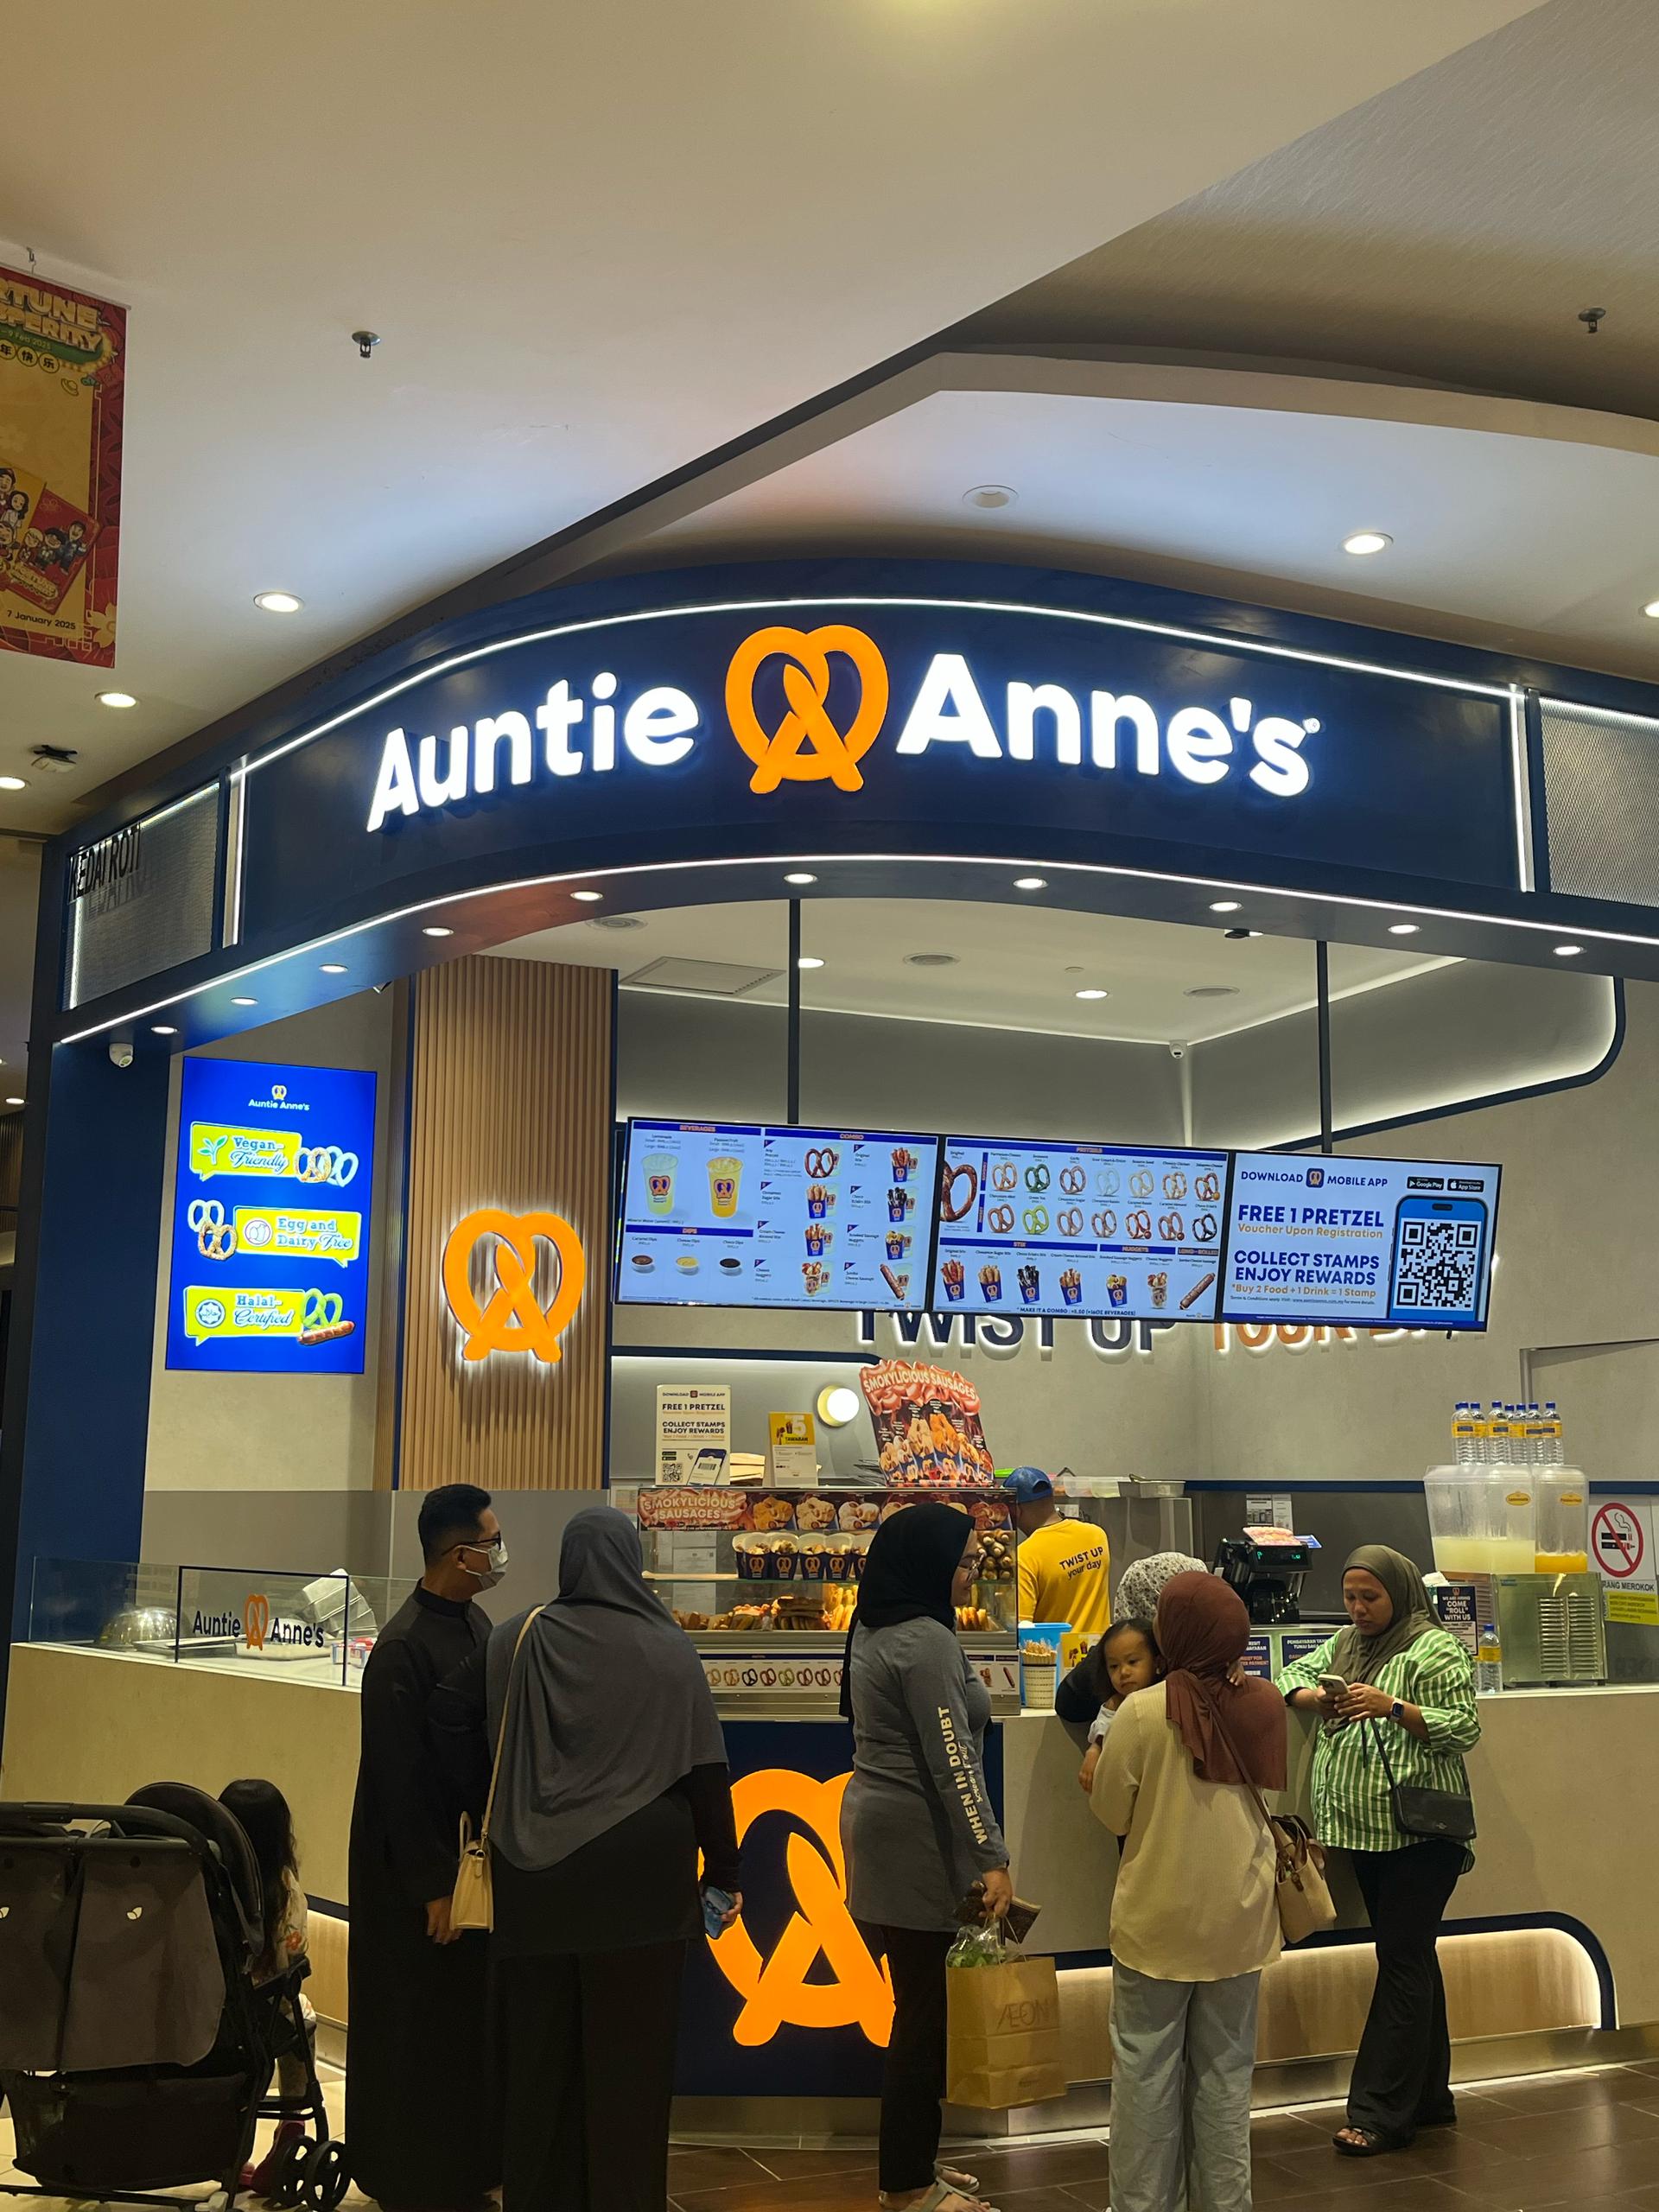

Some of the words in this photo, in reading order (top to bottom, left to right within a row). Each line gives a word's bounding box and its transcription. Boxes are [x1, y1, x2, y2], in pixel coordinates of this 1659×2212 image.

[7, 609, 12, 618] 7
[15, 612, 53, 626] January
[54, 620, 76, 630] 2025
[366, 671, 699, 833] Auntie
[108, 821, 143, 882] ROTI
[248, 1098, 279, 1109] Auntie
[280, 1101, 310, 1111] Anne's
[230, 1151, 289, 1175] Friendly
[1241, 1171, 1303, 1183] DOWNLOAD
[1327, 1175, 1366, 1186] MOBILE
[1368, 1178, 1388, 1187] APP
[277, 1217, 308, 1233] Egg
[310, 1219, 336, 1231] and
[1238, 1205, 1285, 1223] FREE
[1290, 1207, 1297, 1224] 1
[1302, 1208, 1384, 1228] PRETZEL
[1238, 1224, 1285, 1235] Voucher
[1286, 1226, 1314, 1237] Upon
[1317, 1227, 1382, 1239] Registration
[276, 1234, 318, 1251] Dairy
[318, 1235, 353, 1250] Free
[1234, 1249, 1310, 1267] COLLECT
[1313, 1253, 1380, 1269] STAMPS
[1236, 1267, 1292, 1282] ENJOY
[1296, 1269, 1376, 1286] REWARDS
[1264, 1285, 1288, 1294] Food
[1303, 1286, 1329, 1295] Drink
[1344, 1288, 1376, 1298] Stamp
[233, 1308, 293, 1327] Certified
[864, 1369, 931, 1393] SMOKYLICIOUS
[931, 1373, 976, 1400] SAUSAGES
[644, 1496, 735, 1510] SMOKYLICIOUS
[659, 1510, 721, 1519] SAUSAGES
[1059, 1552, 1089, 1571] TWIST
[1090, 1547, 1103, 1558] UP
[1067, 1565, 1085, 1580] your
[1086, 1559, 1102, 1571] day
[1622, 1582, 1655, 1592] MEROKOK
[193, 1610, 241, 1637] Auntie
[270, 1617, 324, 1648] Anne's
[938, 1707, 961, 1768] DOUBT
[953, 1770, 969, 1789] IN
[961, 1793, 988, 1845] WHEN
